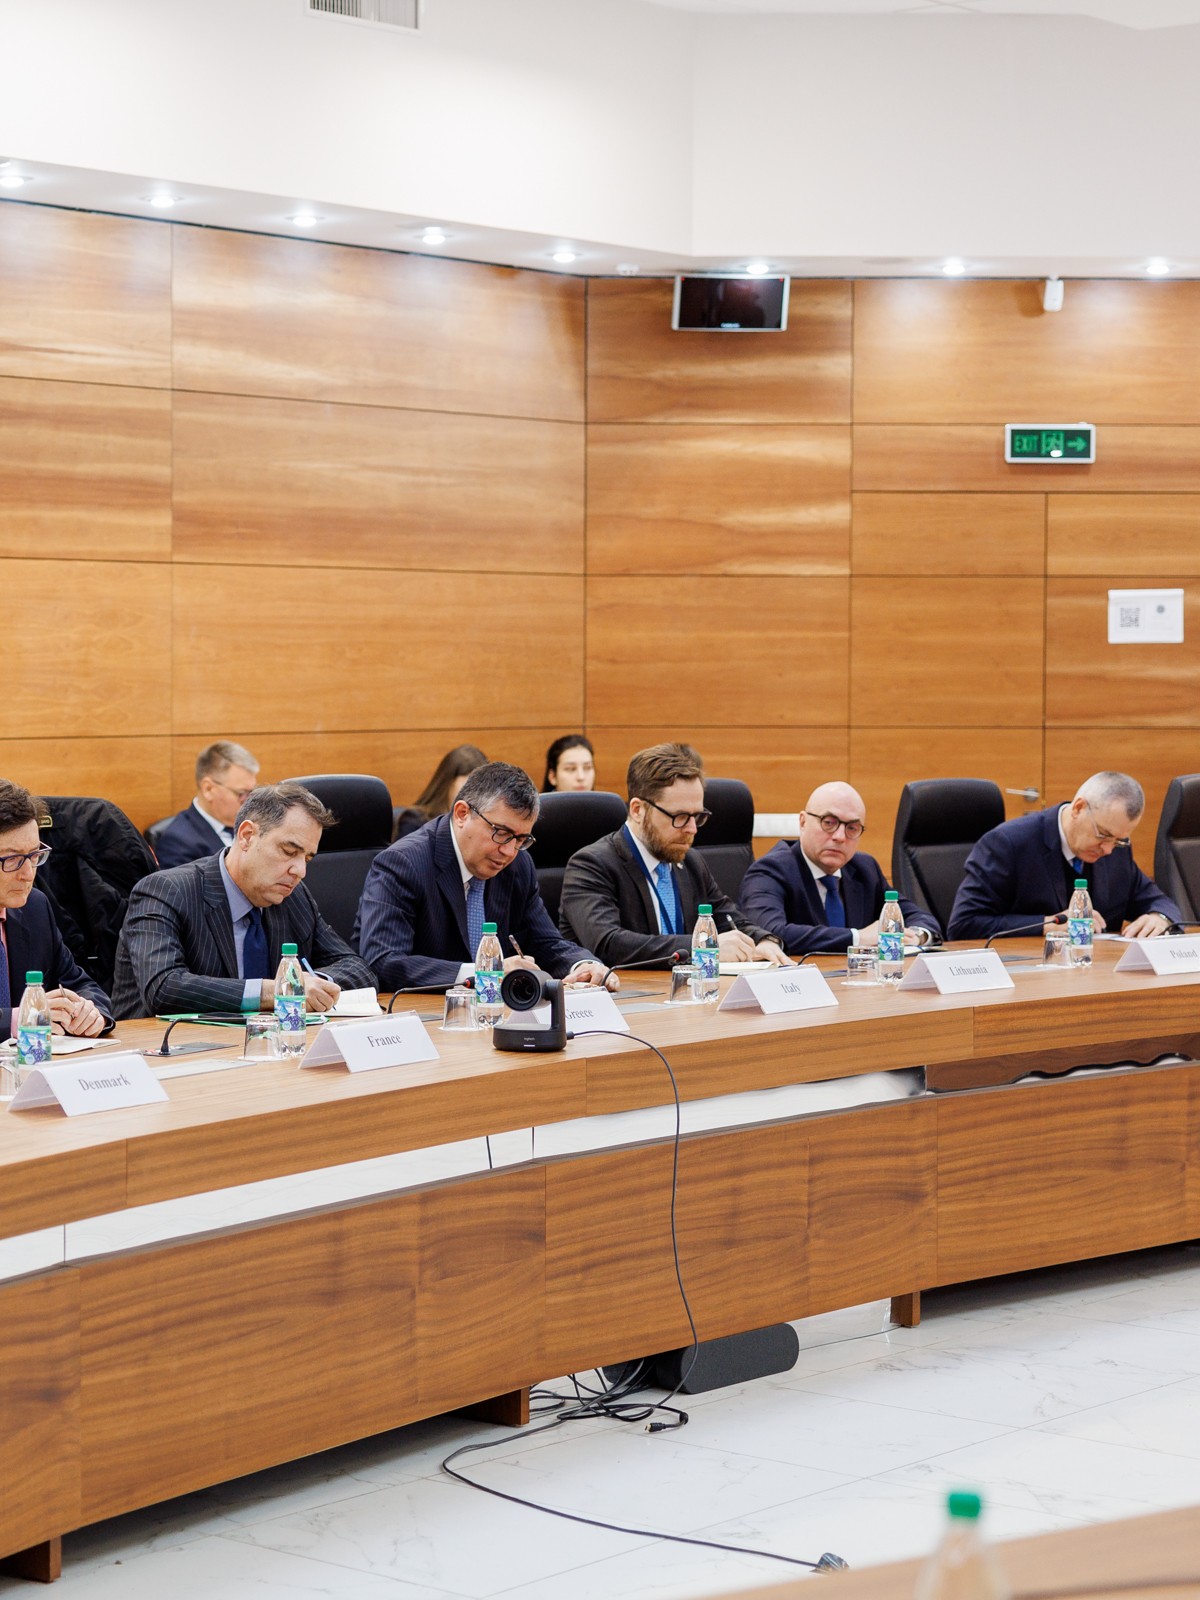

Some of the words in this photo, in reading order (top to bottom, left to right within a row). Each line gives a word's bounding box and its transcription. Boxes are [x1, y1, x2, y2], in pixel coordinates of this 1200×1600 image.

[1014, 435, 1039, 453] EXIT
[1169, 949, 1198, 959] Poland
[949, 965, 989, 977] Lithuania
[780, 983, 802, 995] Italy
[565, 1009, 594, 1020] Greece
[367, 1033, 402, 1048] France
[78, 1073, 132, 1092] Denmark
